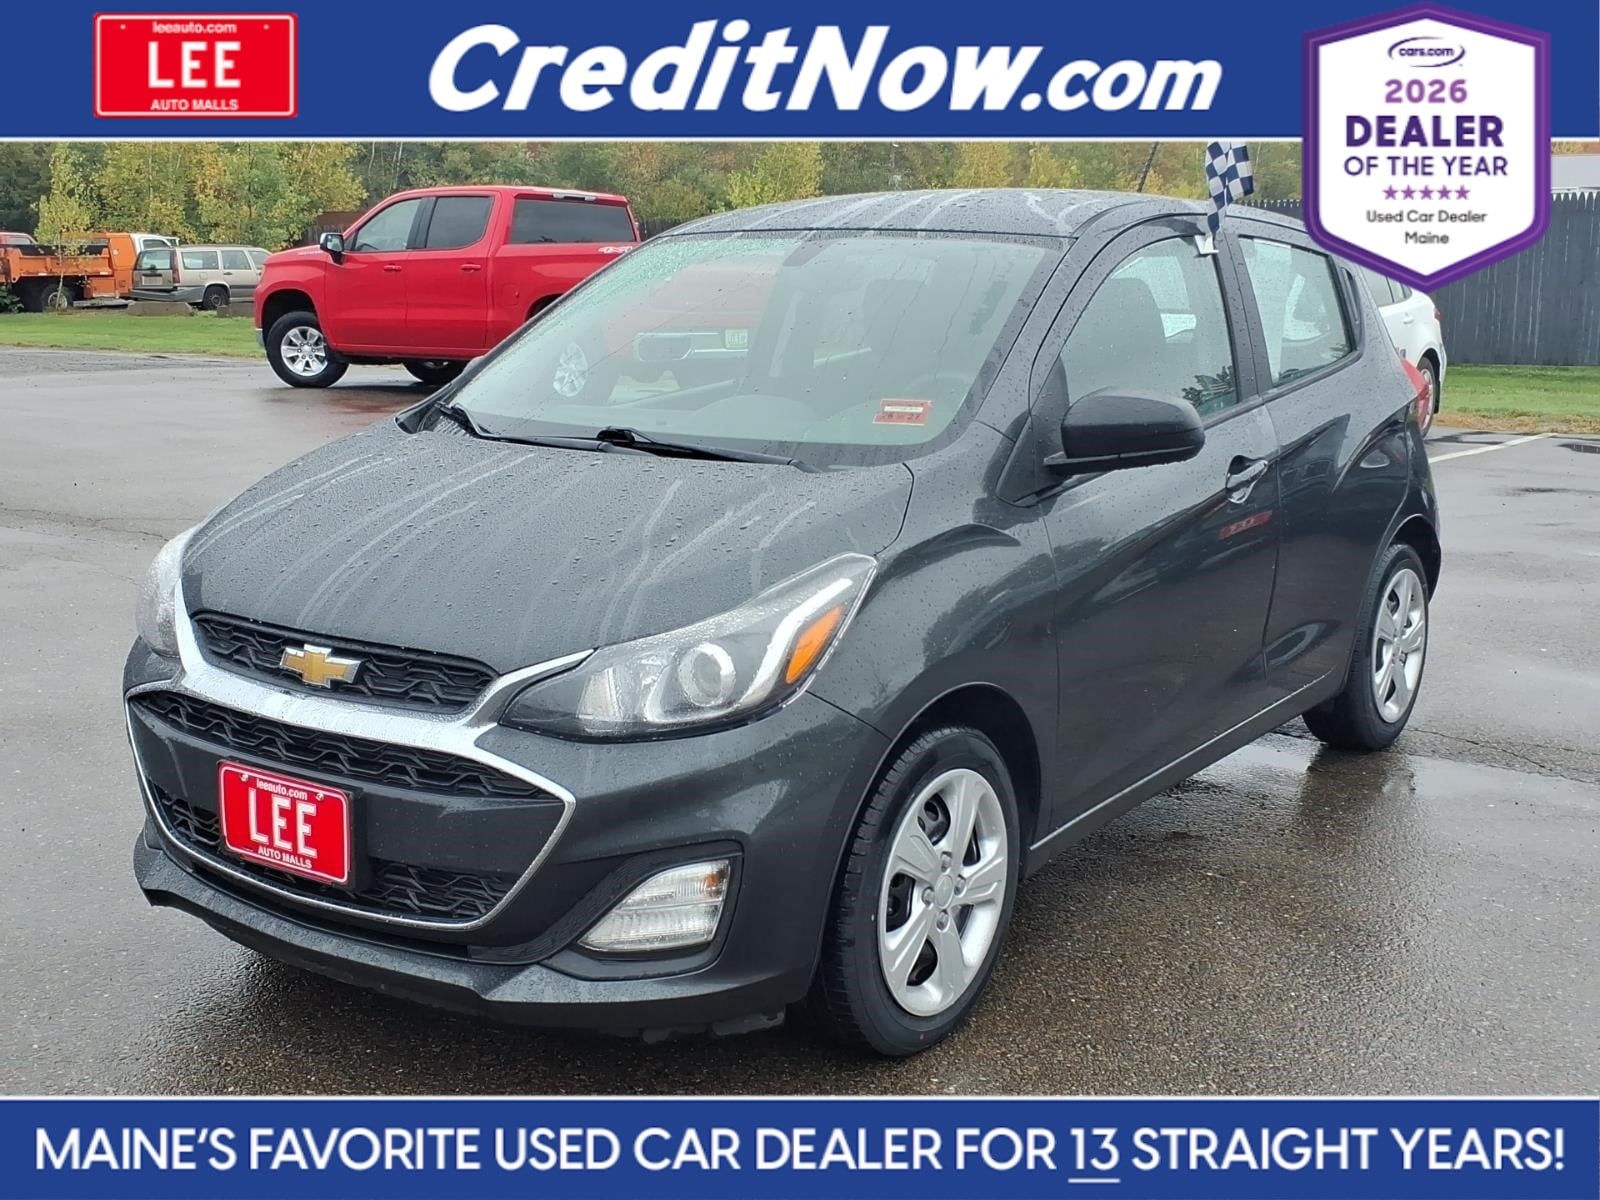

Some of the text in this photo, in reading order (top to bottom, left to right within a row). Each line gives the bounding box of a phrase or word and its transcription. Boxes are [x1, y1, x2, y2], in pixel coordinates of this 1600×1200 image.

[256, 777, 308, 801] leeauto.com
[248, 786, 318, 859] LEE
[257, 845, 312, 869] AUTO MALLS
